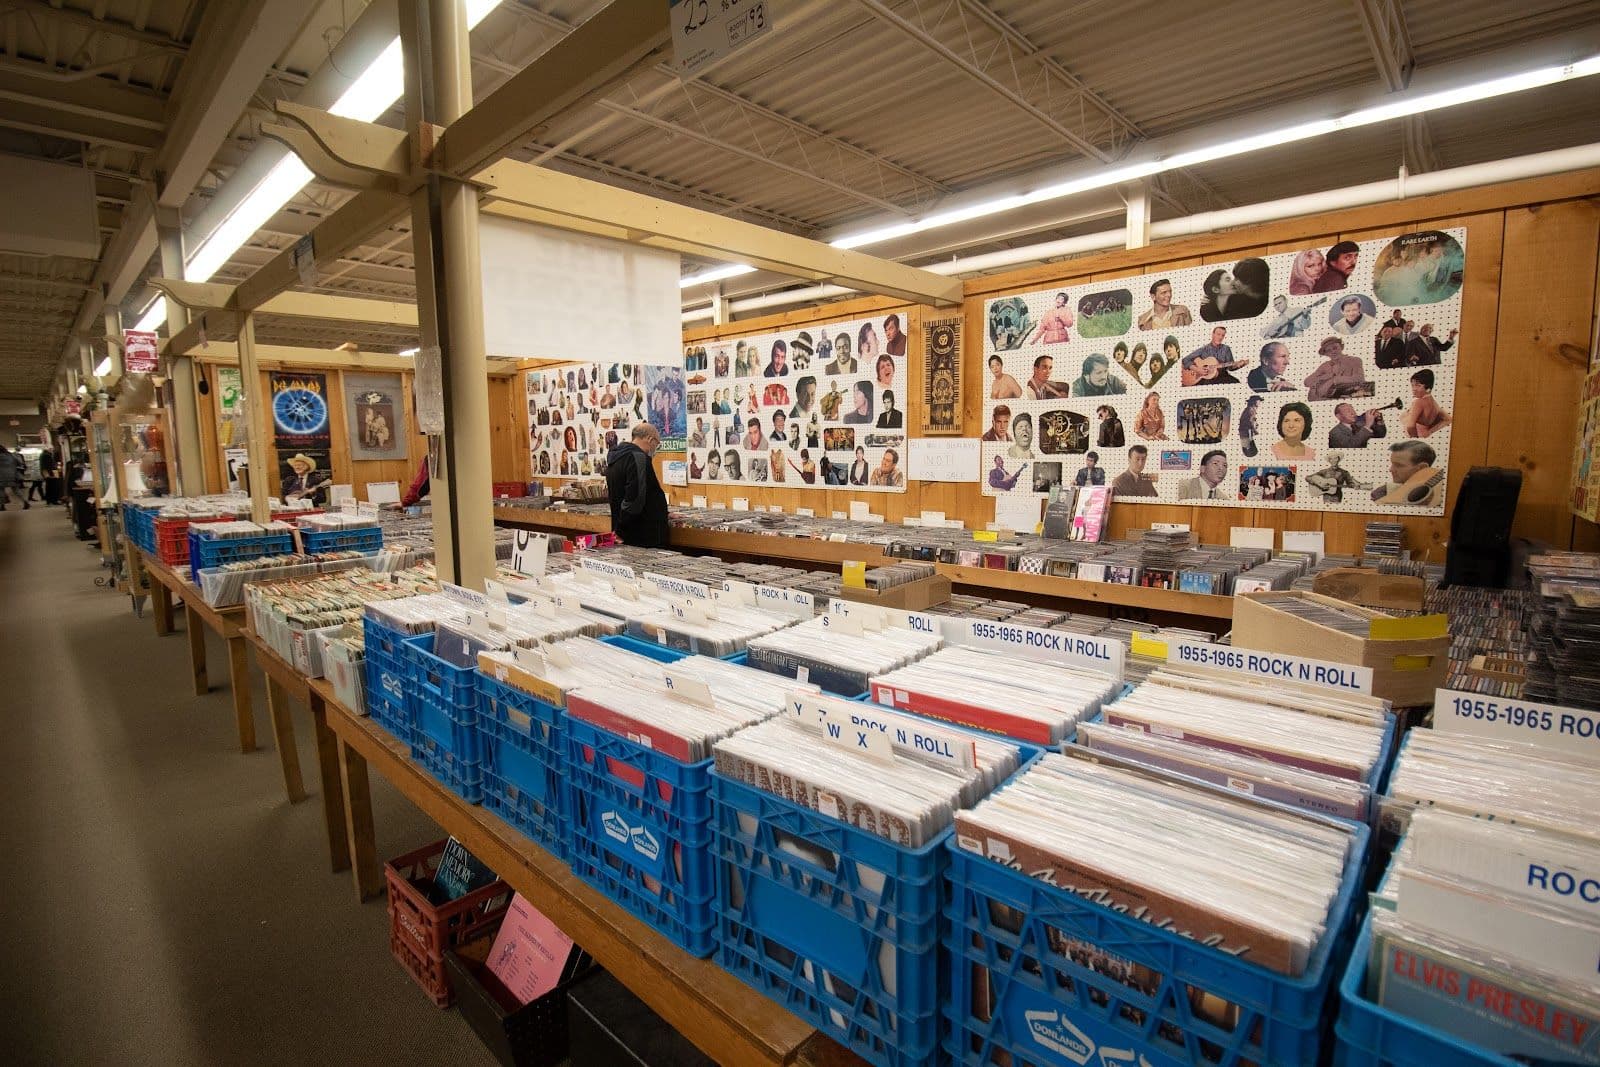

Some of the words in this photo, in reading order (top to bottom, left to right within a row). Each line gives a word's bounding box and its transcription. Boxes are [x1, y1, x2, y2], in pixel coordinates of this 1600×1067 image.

[724, 584, 730, 592] Q
[761, 588, 779, 600] ROCK
[794, 594, 809, 605] OLL
[823, 616, 830, 627] S
[908, 615, 933, 632] ROLL
[972, 622, 1023, 644] 1955-1965
[1026, 630, 1061, 651] ROCK
[1064, 638, 1073, 653] N
[1076, 639, 1111, 660] ROLL
[1178, 645, 1244, 669] 1955-1965
[1248, 655, 1294, 678] ROCK
[1299, 663, 1310, 681] N
[1315, 666, 1361, 689] ROLL
[665, 677, 674, 689] R
[794, 701, 803, 716] Y
[1453, 697, 1553, 731] 1955-1965
[1559, 714, 1600, 740] RO
[826, 722, 841, 739] W
[857, 731, 868, 748] X
[897, 728, 907, 744] N
[914, 733, 954, 758] ROLL
[1393, 950, 1461, 997] ELVIS
[1466, 978, 1590, 1047] PRESLEY
[1033, 1022, 1087, 1055] DONLANDS
